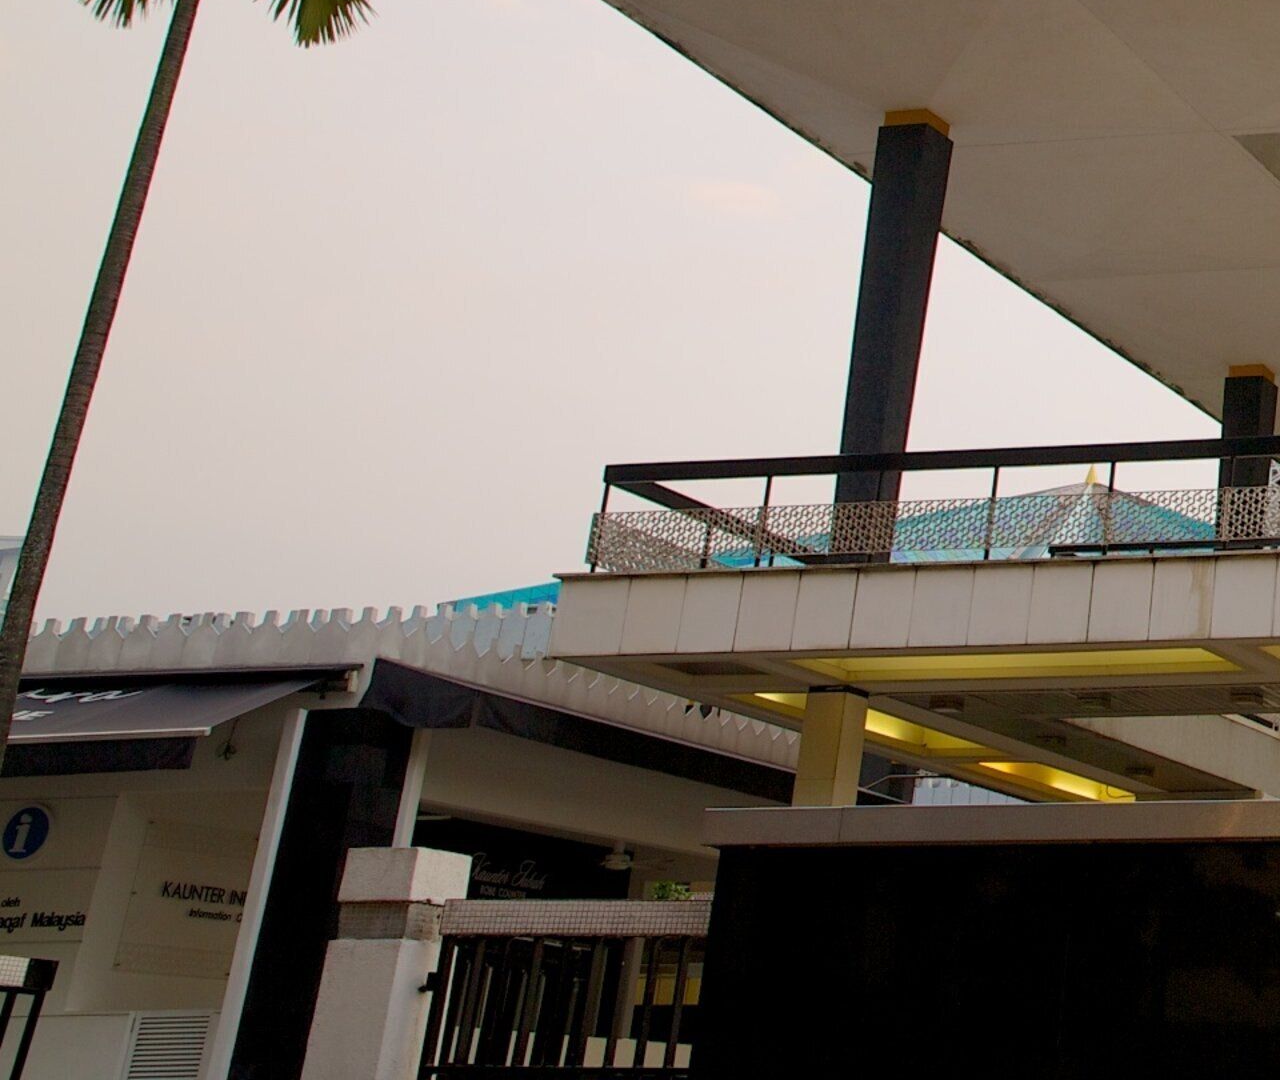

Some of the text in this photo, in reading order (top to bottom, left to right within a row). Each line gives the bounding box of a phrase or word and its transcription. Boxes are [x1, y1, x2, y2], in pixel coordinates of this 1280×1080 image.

[161, 881, 226, 905] KAUNTER
[31, 911, 87, 931] Malaysia
[188, 907, 232, 921] Information
